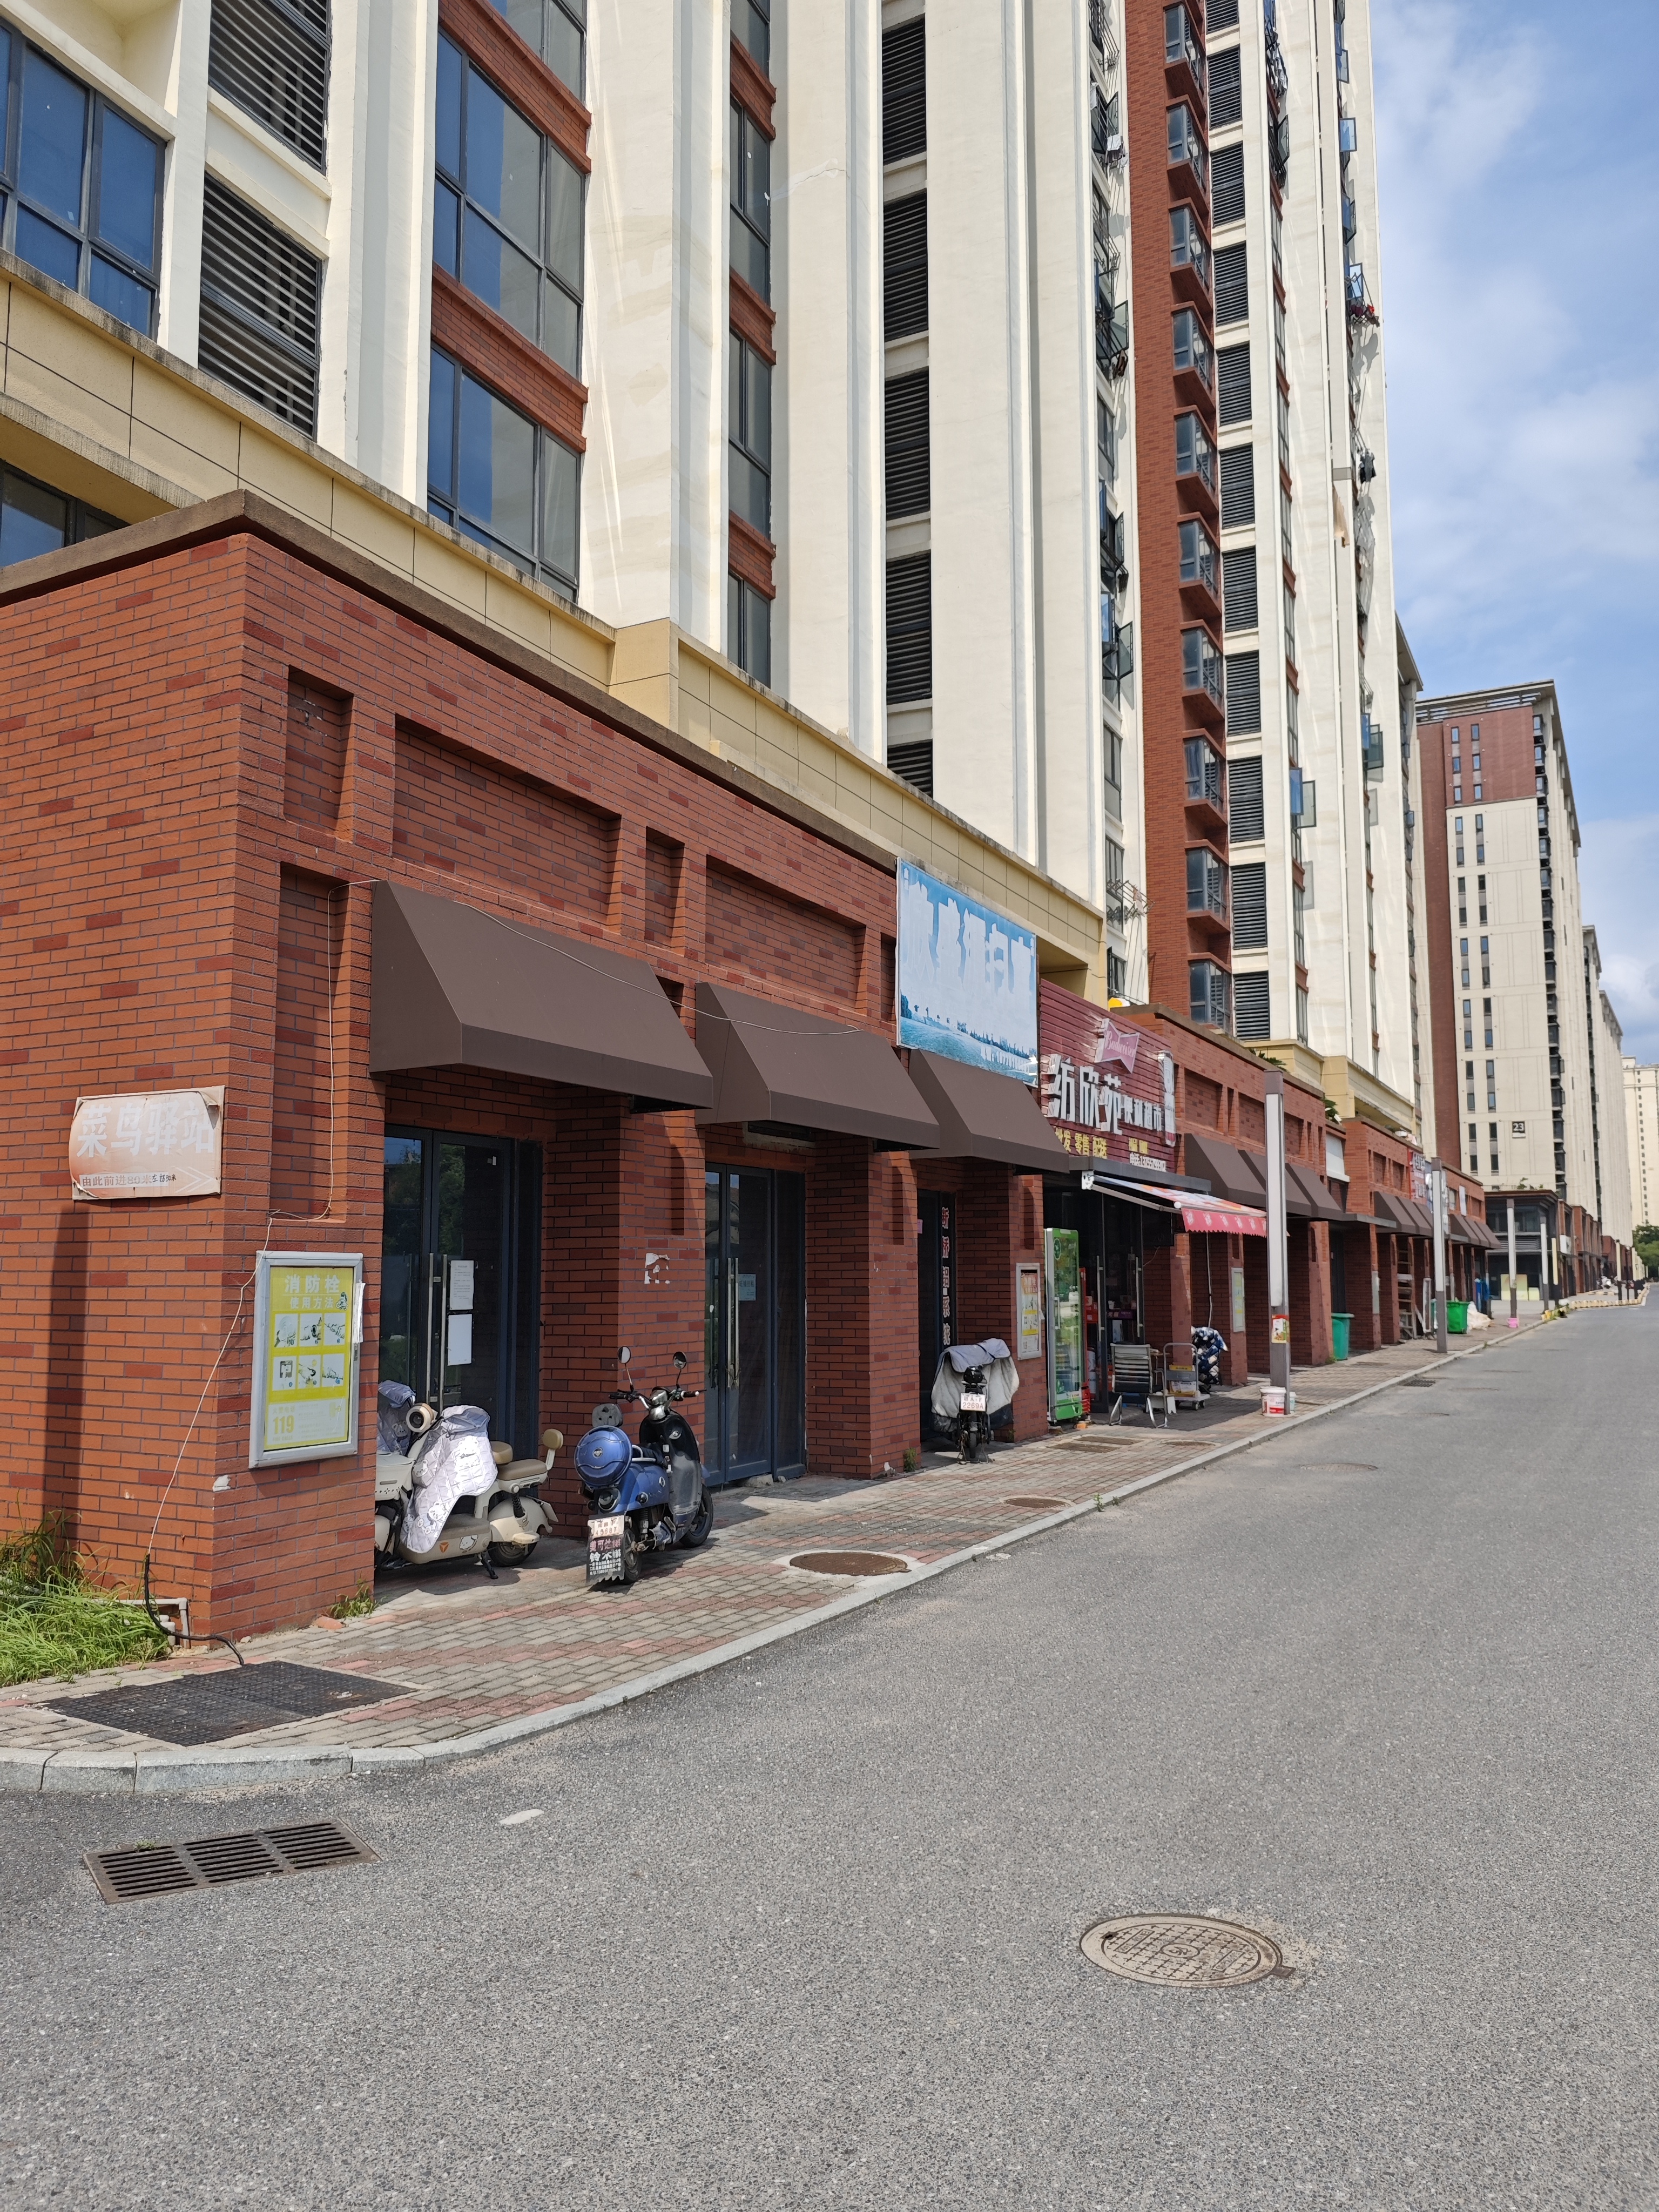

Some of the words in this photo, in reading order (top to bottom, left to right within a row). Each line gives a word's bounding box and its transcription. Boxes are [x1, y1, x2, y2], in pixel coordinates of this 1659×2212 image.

[1104, 1030, 1136, 1057] Budweiser
[77, 1101, 215, 1158] 菜鸟驿站
[1513, 1122, 1524, 1132] 23
[1055, 1127, 1071, 1152] 批发
[1074, 1132, 1090, 1156] 零售
[1092, 1137, 1107, 1159] 配送
[83, 1174, 152, 1186] 由此前进80米
[285, 1273, 340, 1293] 消防栓
[290, 1296, 334, 1310] 使用方法
[273, 1415, 295, 1434] 119
